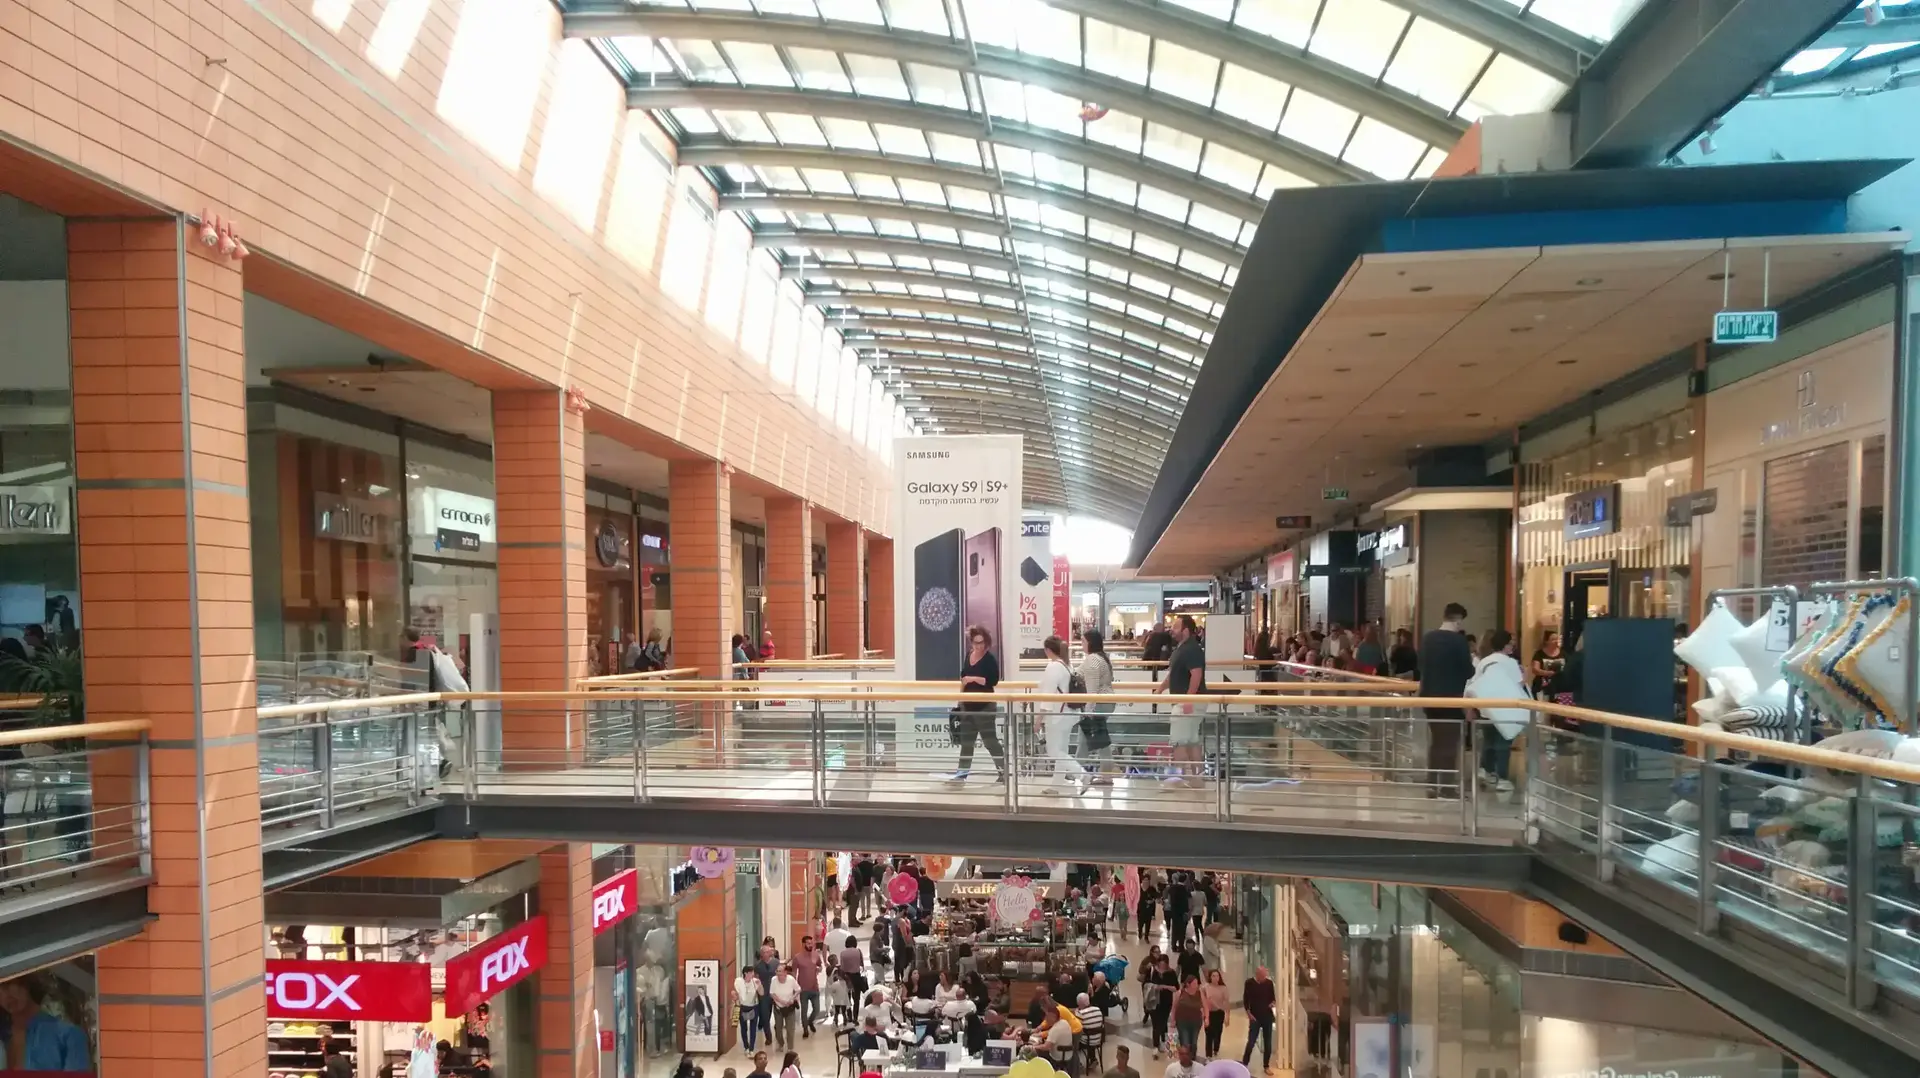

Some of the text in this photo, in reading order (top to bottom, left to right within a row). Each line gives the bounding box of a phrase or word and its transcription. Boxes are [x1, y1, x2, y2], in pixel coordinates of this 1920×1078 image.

[906, 451, 950, 459] SAMSUNG
[907, 481, 959, 496] Galaxy
[962, 481, 978, 493] S9
[986, 480, 1008, 492] S9+
[919, 498, 948, 506] מוקדמת
[593, 884, 625, 928] FOX
[1002, 892, 1028, 907] Hello
[481, 935, 530, 993] FOX
